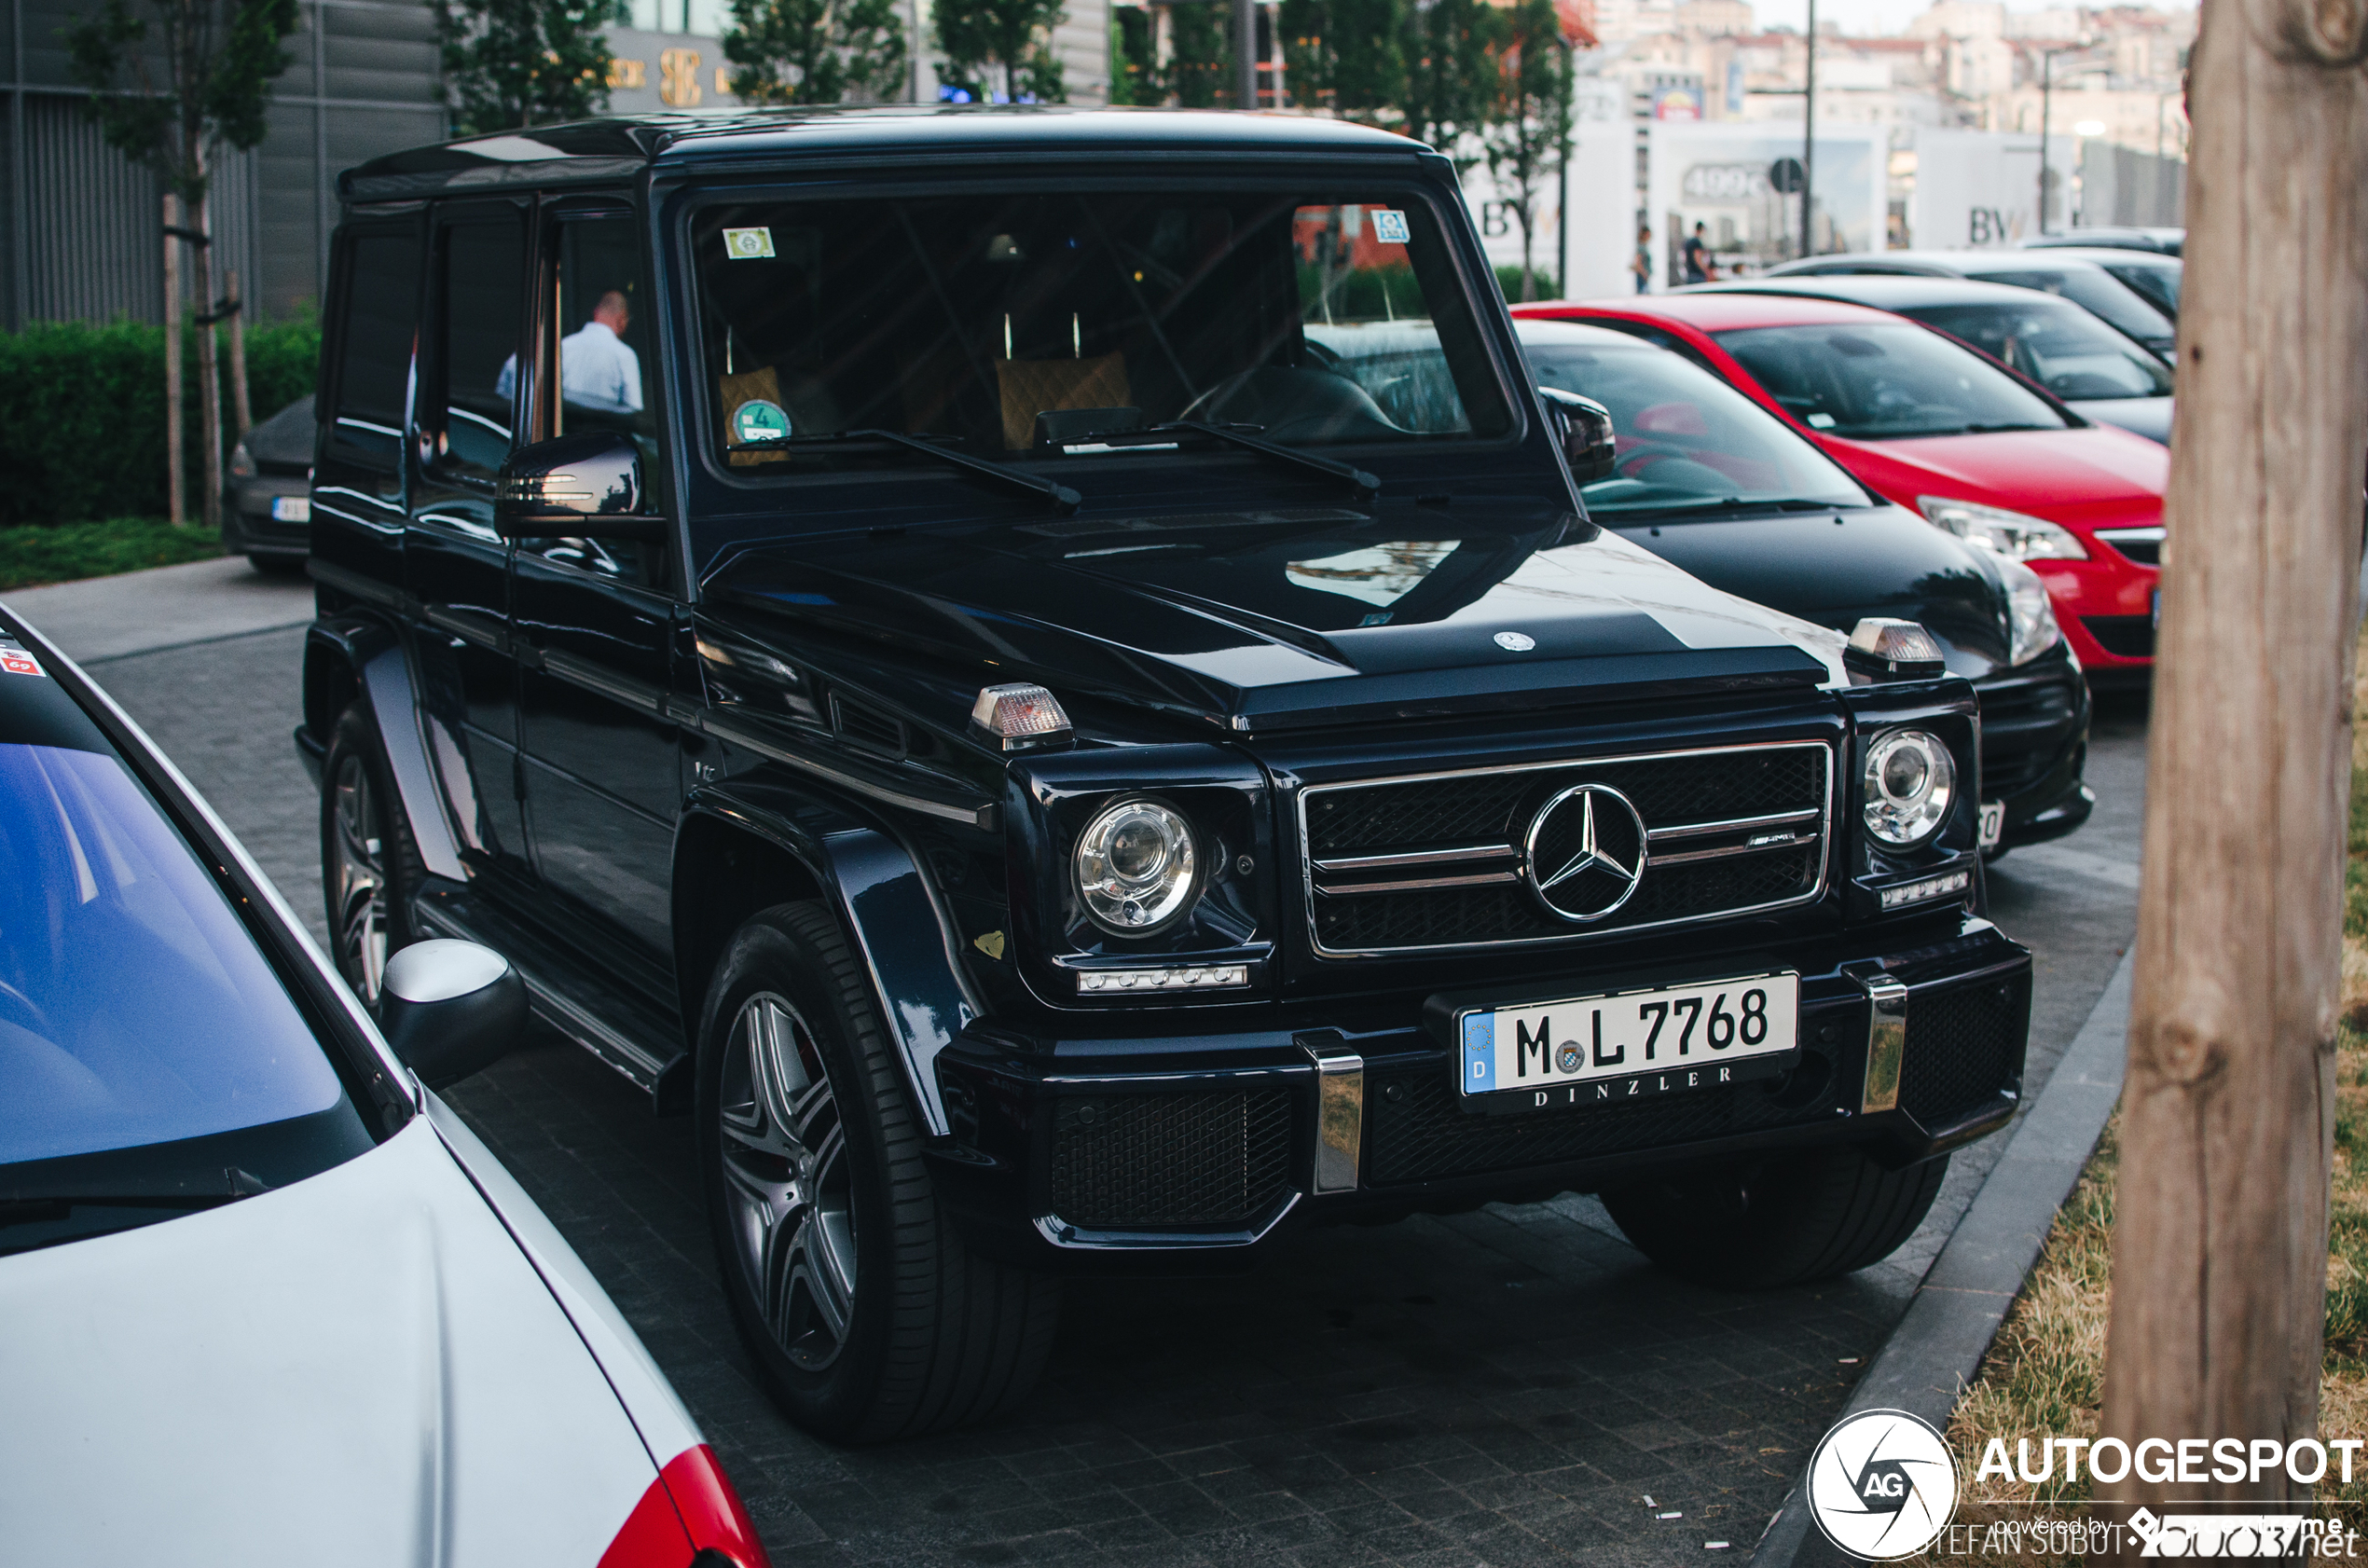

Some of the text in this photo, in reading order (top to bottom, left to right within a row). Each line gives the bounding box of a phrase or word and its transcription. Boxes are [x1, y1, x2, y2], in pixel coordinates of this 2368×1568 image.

[755, 407, 770, 427] 4
[1516, 1015, 1551, 1078] M
[1592, 1010, 1625, 1067] L
[1640, 988, 1769, 1061] 7768
[1473, 1061, 1485, 1079] D
[1535, 1066, 1731, 1107] DINZLER
